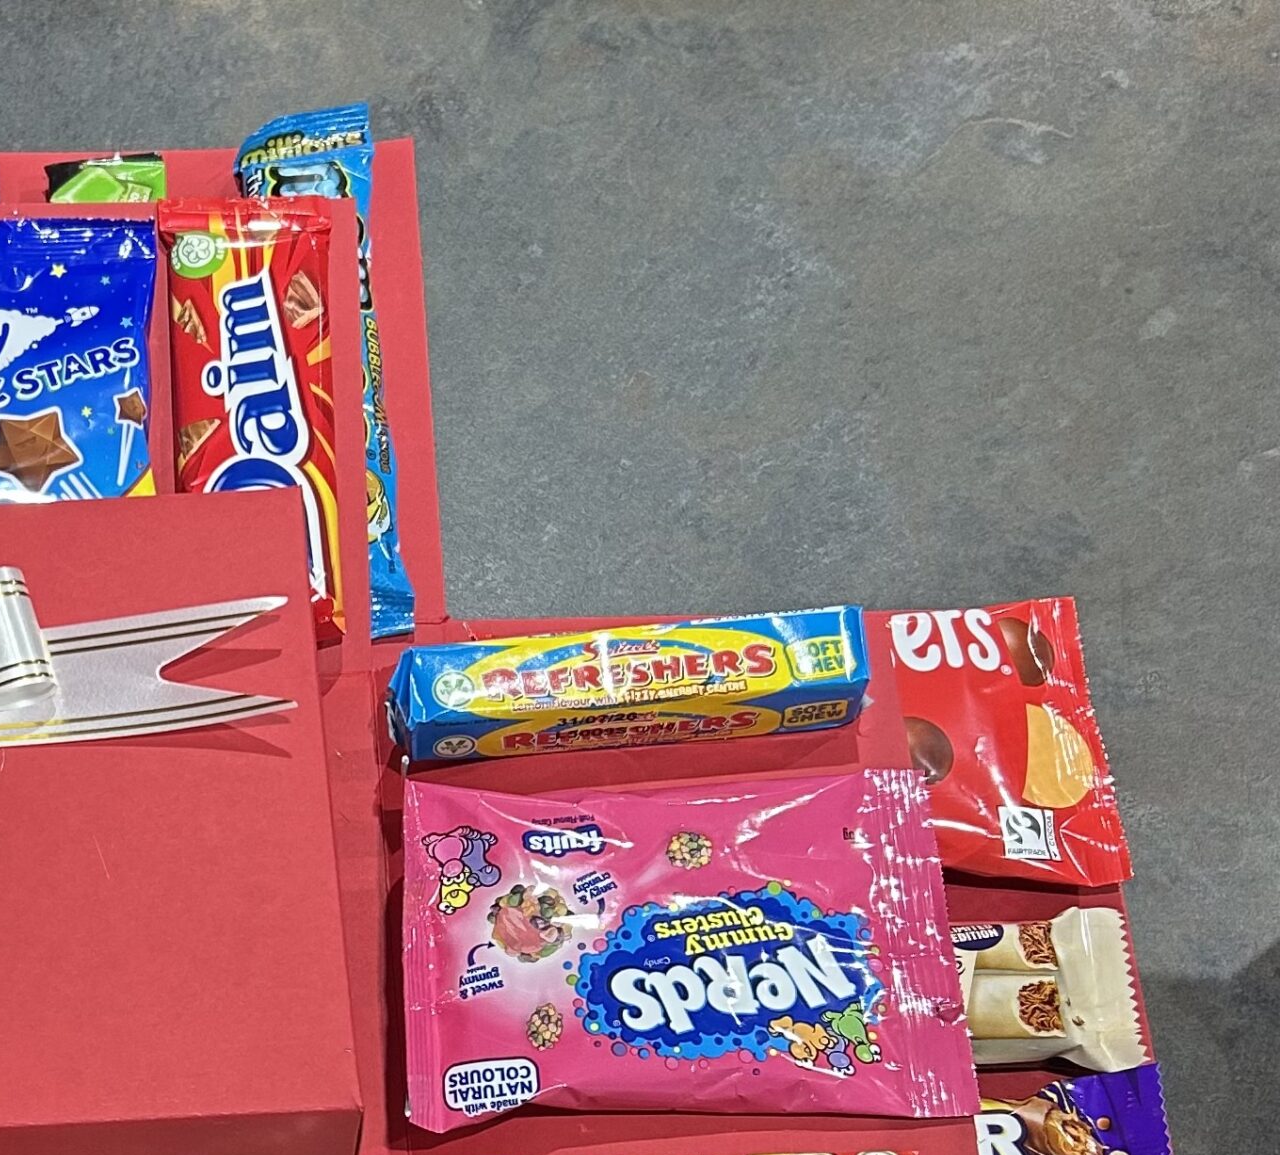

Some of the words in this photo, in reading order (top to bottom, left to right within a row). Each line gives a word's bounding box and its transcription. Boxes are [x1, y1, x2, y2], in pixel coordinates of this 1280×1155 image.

[14, 339, 137, 395] STARS
[481, 642, 777, 702] REFRESHERS
[786, 710, 844, 724] CHEW
[792, 702, 842, 715] SOFT
[528, 827, 602, 853] fruits
[684, 920, 794, 957] Gummy
[458, 966, 501, 988] gummy
[471, 979, 505, 996] sweet
[458, 989, 469, 1000] &
[448, 1064, 532, 1087] COLOURS
[448, 1079, 534, 1101] NATURAL
[464, 1100, 488, 1115] with
[490, 1097, 519, 1113] made
